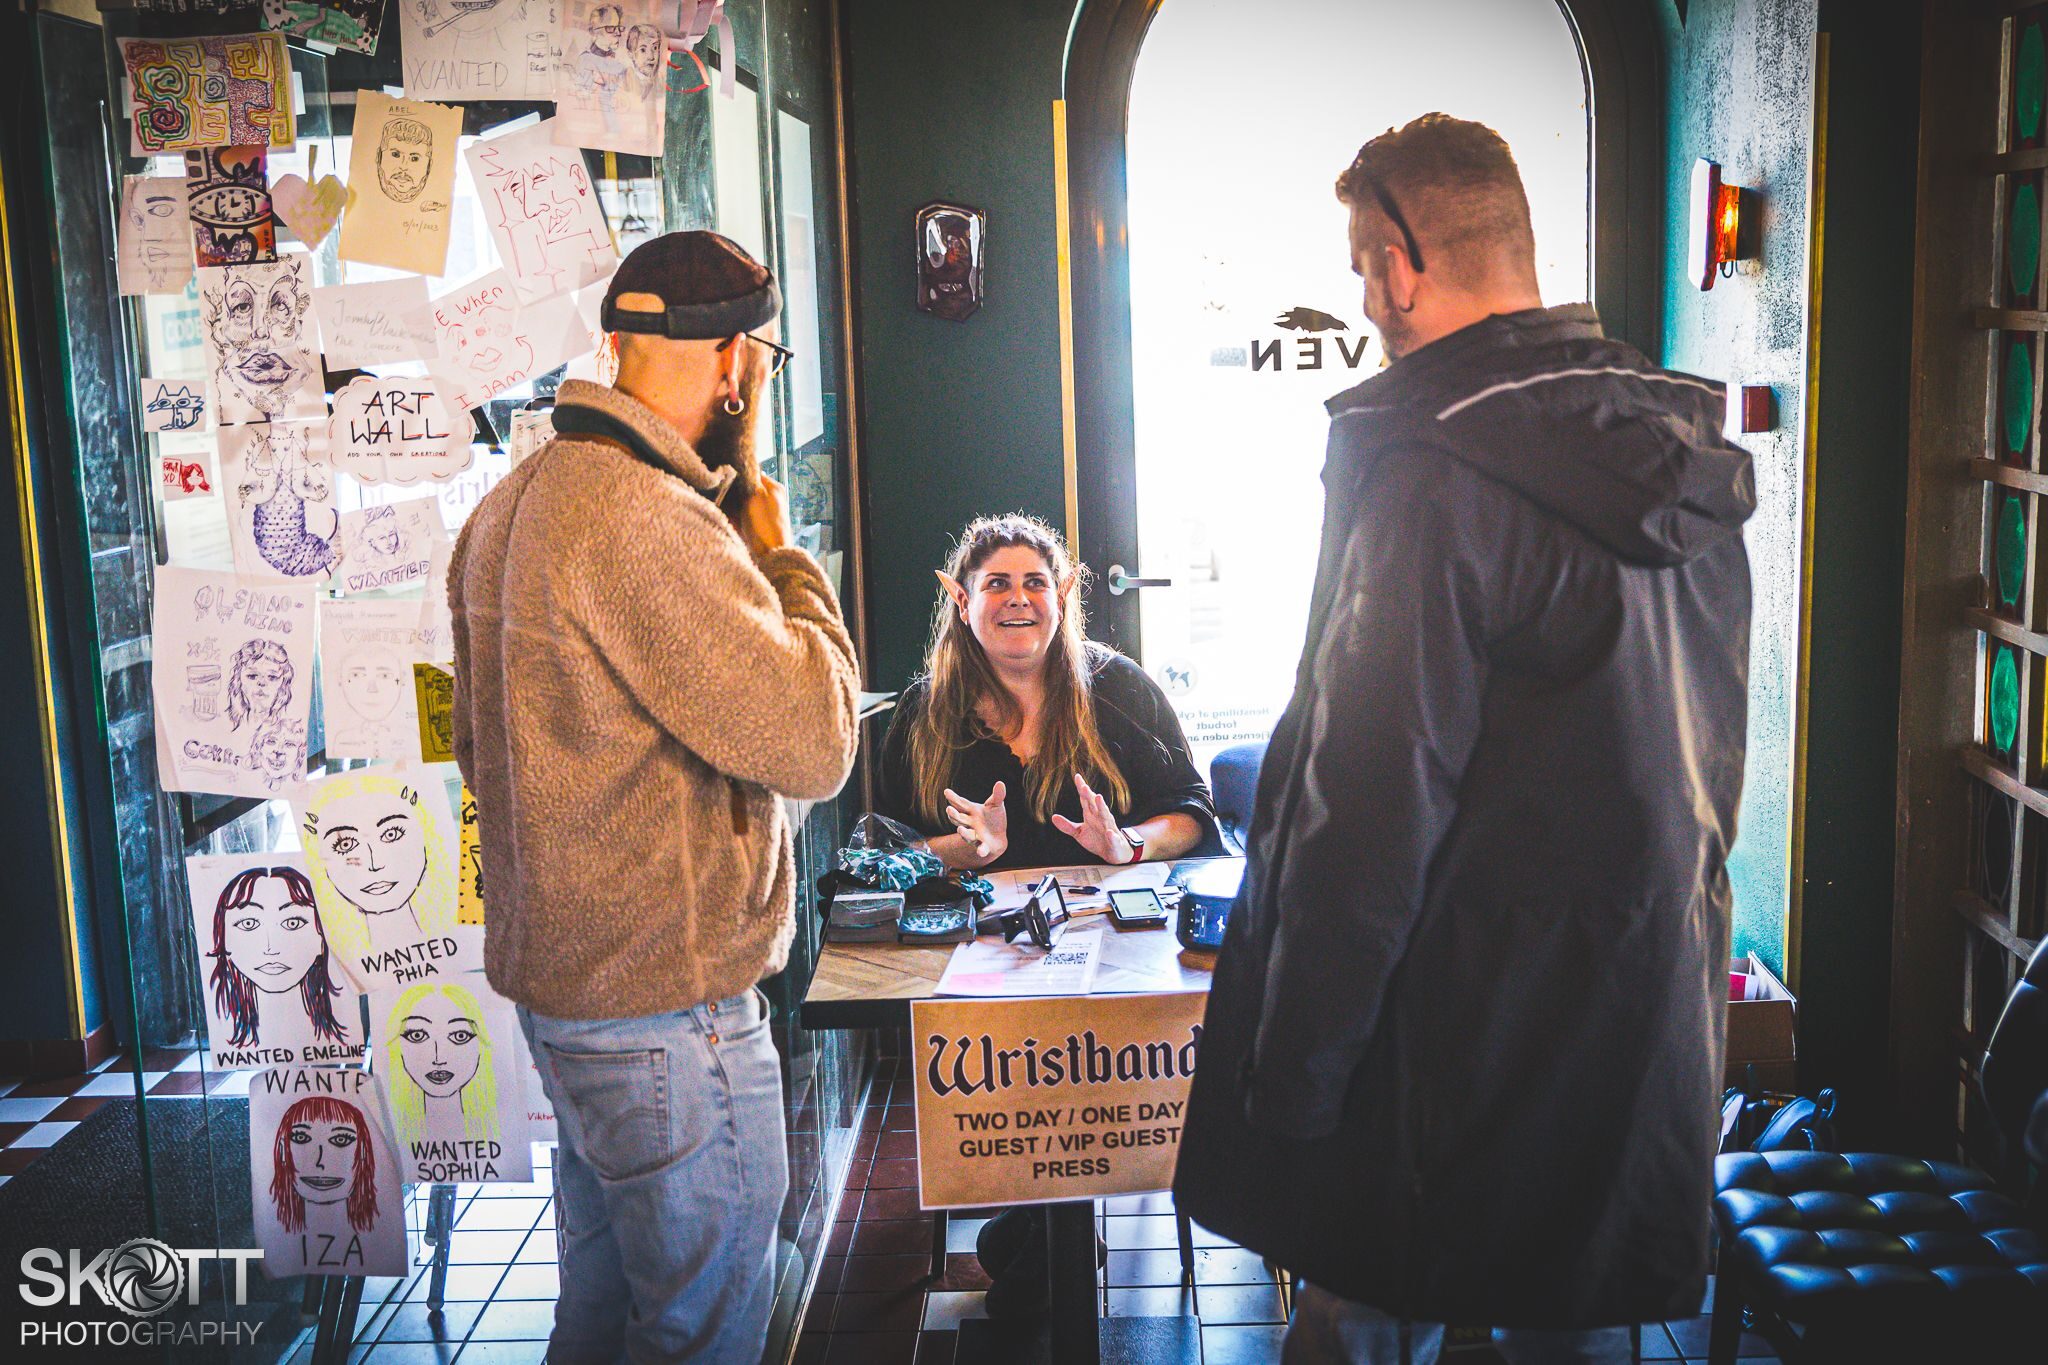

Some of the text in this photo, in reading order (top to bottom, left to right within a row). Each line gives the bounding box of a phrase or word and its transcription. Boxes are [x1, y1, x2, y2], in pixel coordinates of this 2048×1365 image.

[406, 55, 509, 92] WANTED
[388, 105, 411, 114] ABEL
[455, 285, 503, 316] When
[361, 390, 435, 416] ART
[454, 369, 527, 410] I JAM
[350, 418, 450, 445] WALL
[347, 560, 431, 591] WANTED
[361, 937, 458, 974] WANTED
[393, 962, 439, 984] PHIA
[217, 1042, 366, 1068] WANTED EMELINE
[265, 1069, 367, 1094] WANTE
[954, 1112, 1009, 1132] TWO
[1015, 1108, 1062, 1129] DAY
[1081, 1105, 1131, 1125] ONE
[1138, 1101, 1185, 1121] DAY
[411, 1140, 501, 1162] WANTED
[959, 1136, 1039, 1158] GUEST
[1058, 1133, 1096, 1152] VIP
[1102, 1127, 1182, 1149] GUEST
[417, 1161, 500, 1183] SOPHIA
[1032, 1157, 1111, 1180] PRESS
[302, 1234, 365, 1268] IZA
